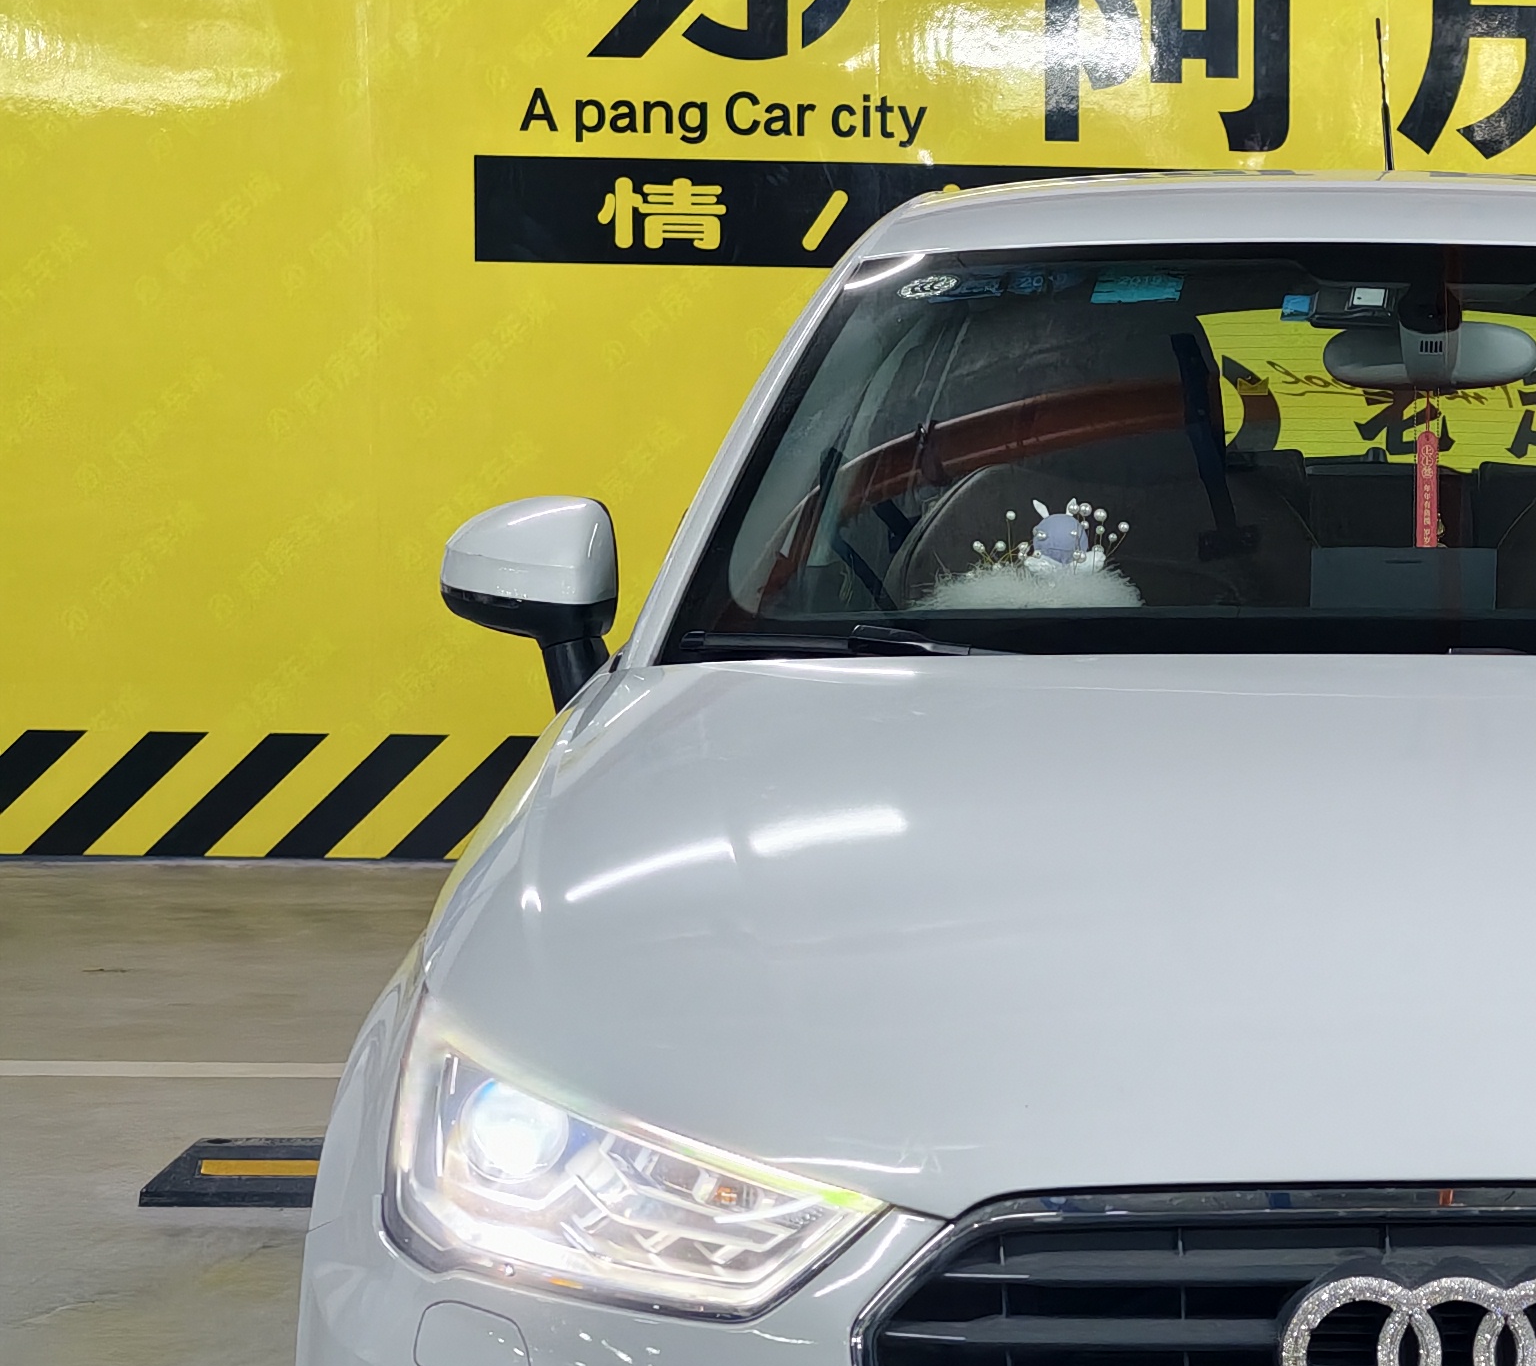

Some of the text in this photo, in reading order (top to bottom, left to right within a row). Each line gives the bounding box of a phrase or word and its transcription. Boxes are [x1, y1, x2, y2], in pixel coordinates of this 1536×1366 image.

[520, 88, 928, 148] A pang Car city
